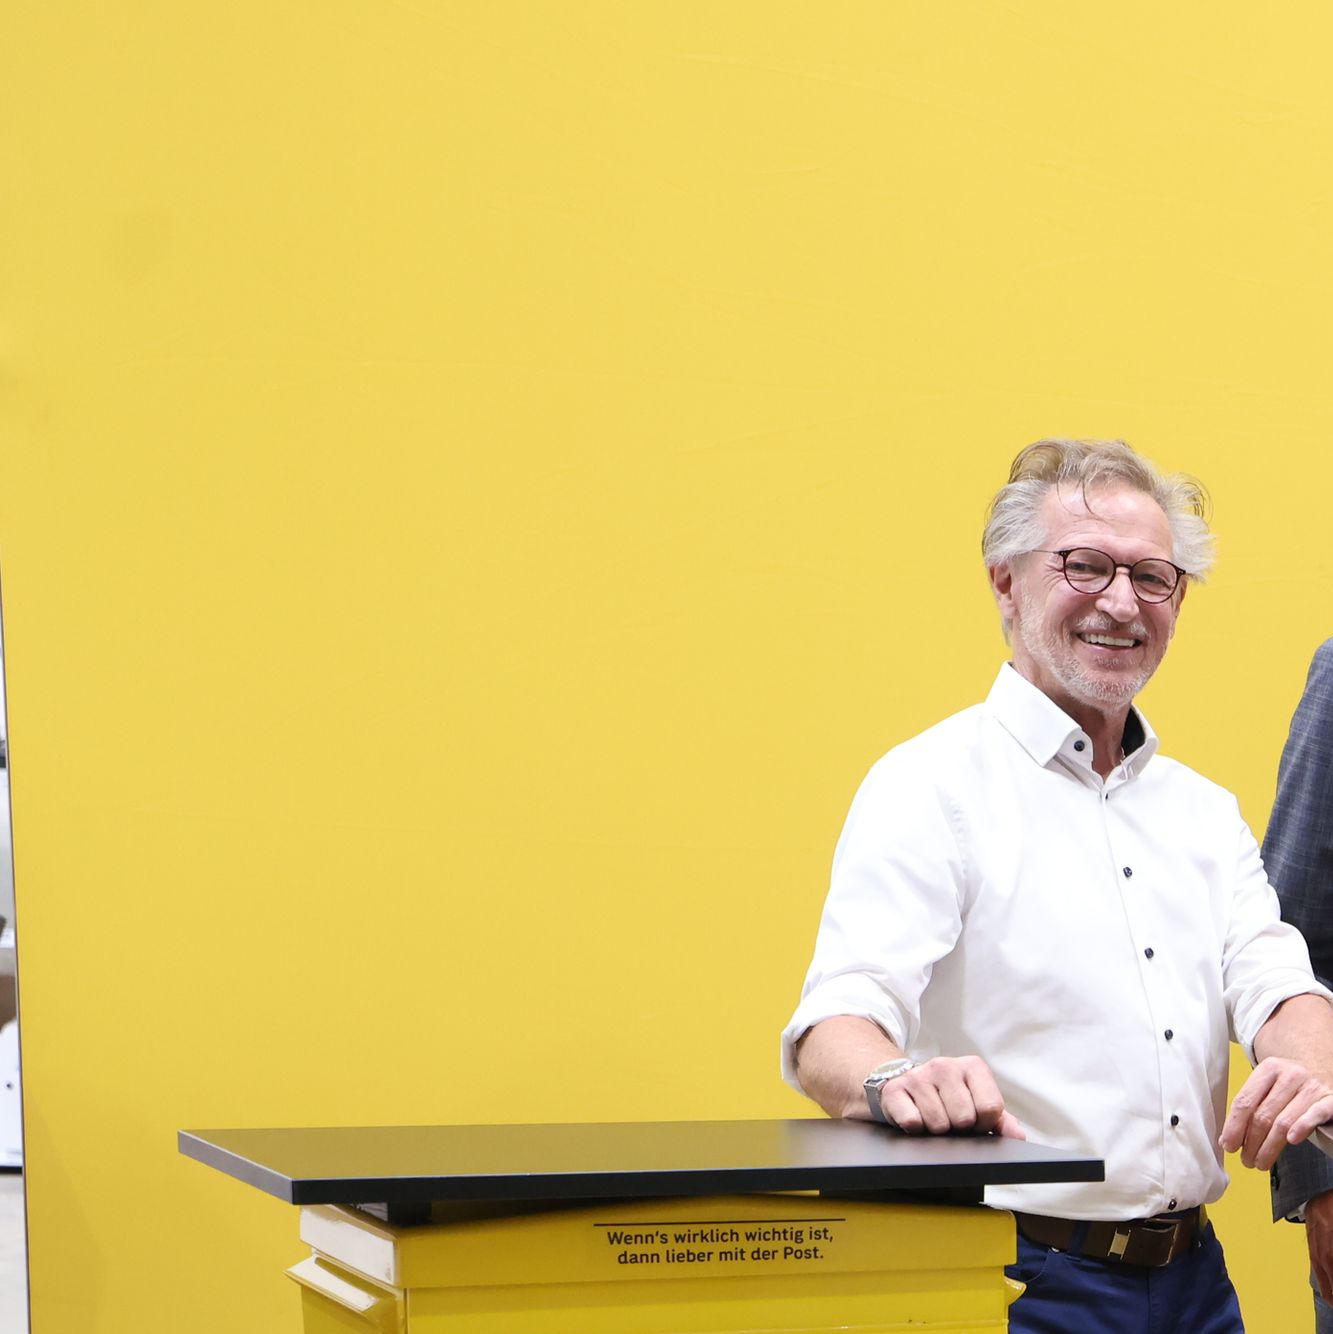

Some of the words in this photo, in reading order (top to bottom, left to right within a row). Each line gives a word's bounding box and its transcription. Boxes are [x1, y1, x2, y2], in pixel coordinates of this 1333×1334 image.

[674, 1229, 739, 1243] wirklich
[745, 1228, 803, 1243] wichtig
[809, 1227, 833, 1242] ist,
[618, 1251, 660, 1264] dann
[666, 1249, 713, 1262] lieber
[719, 1248, 746, 1261] mit
[751, 1247, 778, 1260] der
[783, 1246, 824, 1260] Post.
